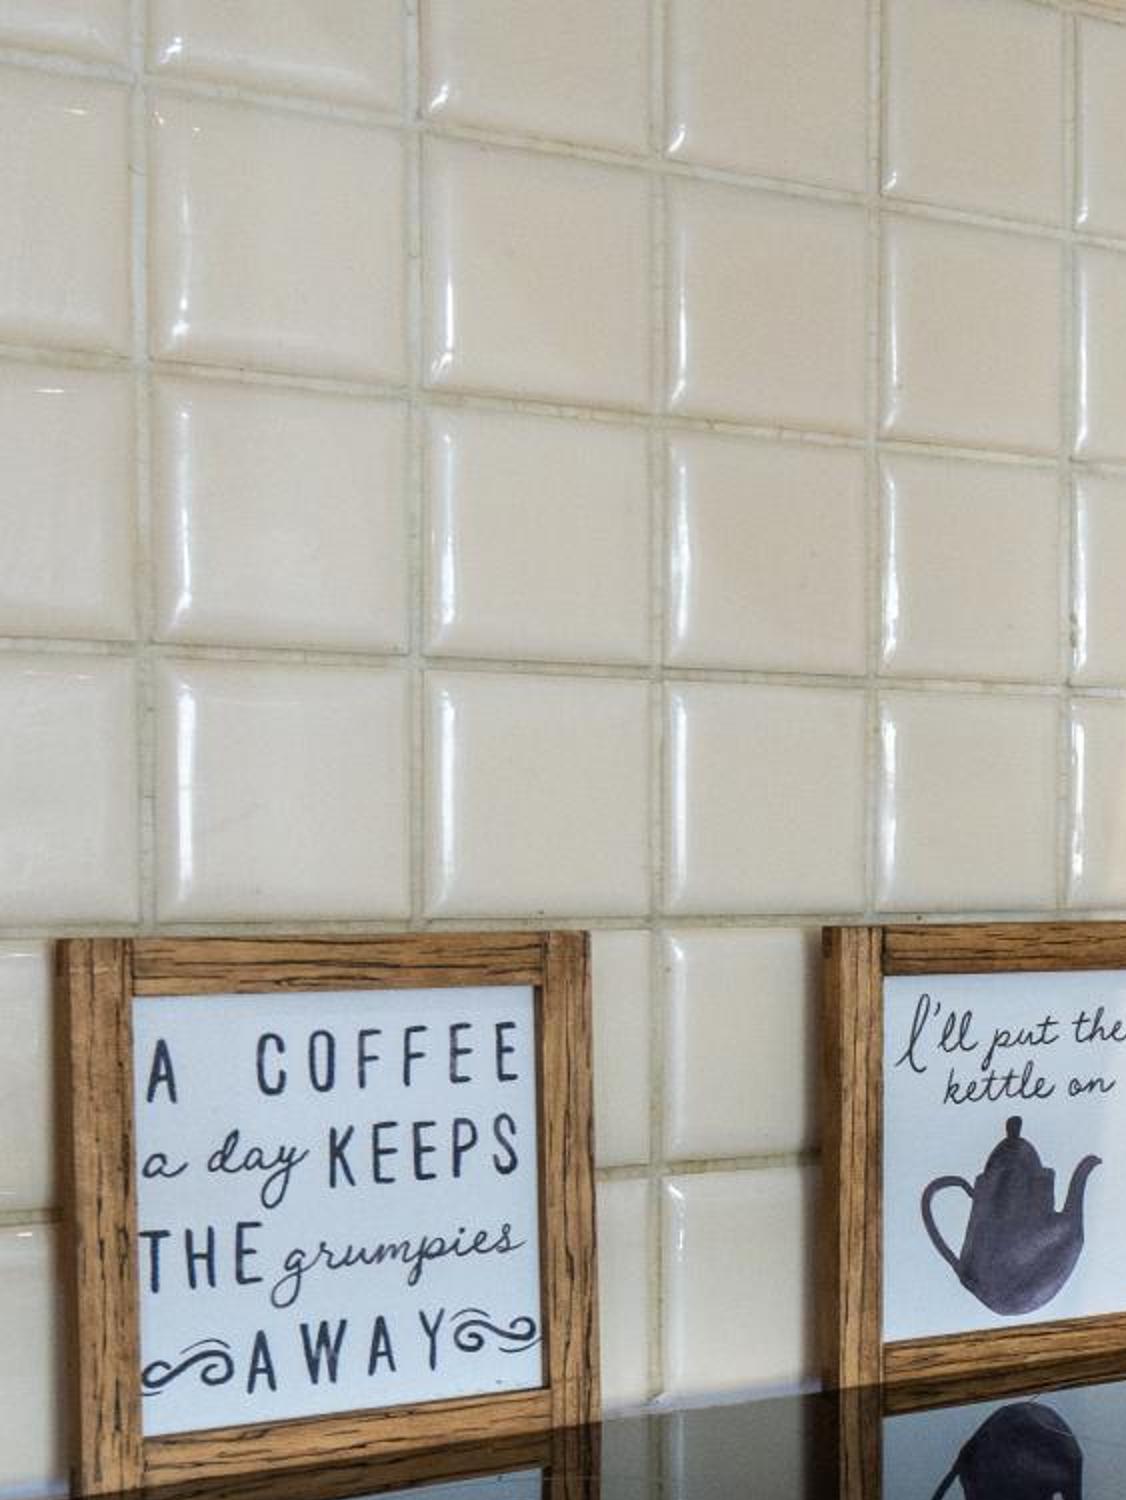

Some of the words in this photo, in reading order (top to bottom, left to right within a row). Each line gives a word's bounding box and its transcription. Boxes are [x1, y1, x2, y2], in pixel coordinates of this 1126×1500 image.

[146, 1039, 178, 1103] A
[256, 1022, 519, 1095] COFFEE
[943, 1060, 1056, 1105] kettle
[1068, 1076, 1117, 1097] on
[981, 1015, 1060, 1071] put
[142, 1152, 187, 1180] a
[206, 1129, 310, 1209] day
[328, 1113, 519, 1188] KEEPS
[138, 1221, 264, 1293] THE
[270, 1223, 527, 1308] grumpies
[247, 1308, 445, 1394] AWAY
